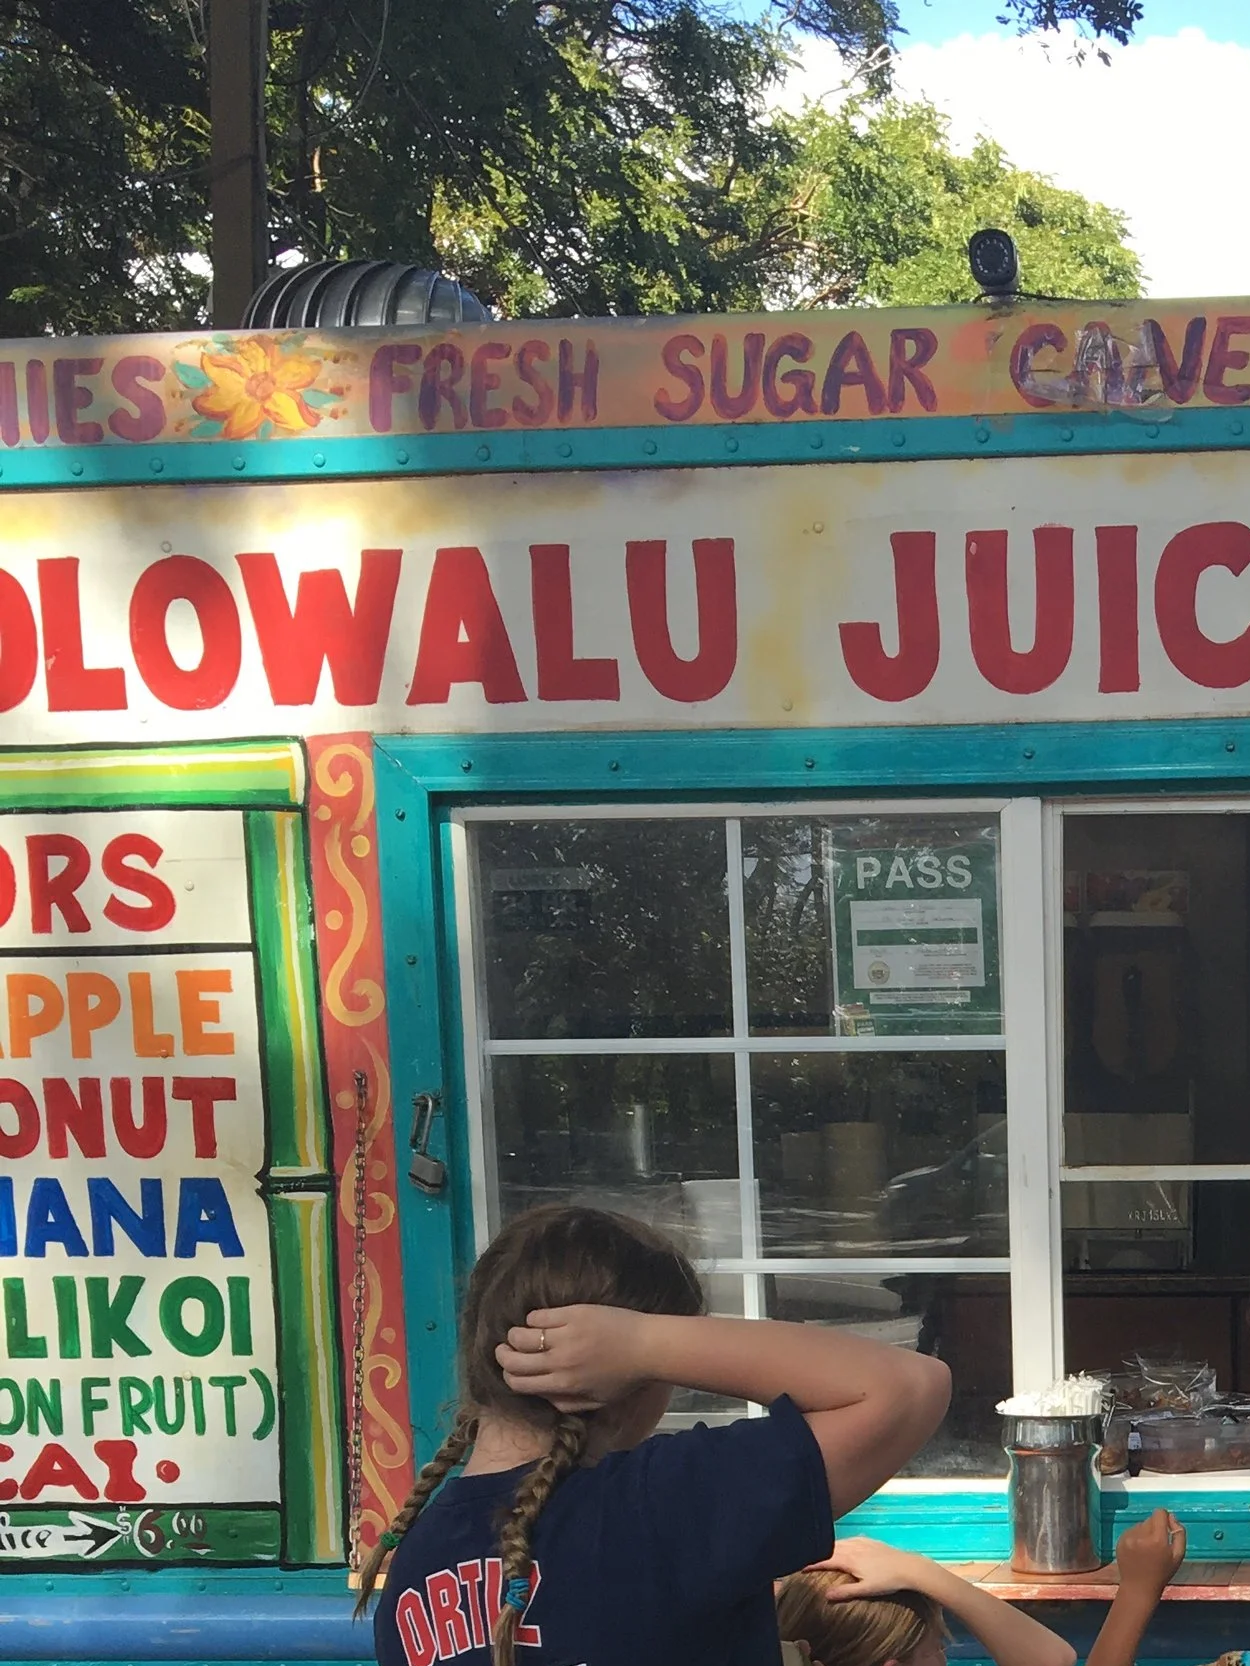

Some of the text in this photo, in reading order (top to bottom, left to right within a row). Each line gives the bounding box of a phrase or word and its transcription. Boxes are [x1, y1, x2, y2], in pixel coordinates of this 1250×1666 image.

[368, 337, 599, 433] FRESH
[653, 327, 938, 422] SUGAR
[0, 833, 177, 935] RS
[855, 854, 973, 890] PASS
[0, 969, 236, 1060] PPLE
[0, 1175, 246, 1259] ANA
[2, 1275, 254, 1359] LIKOI
[80, 1367, 276, 1441] FRUIT)
